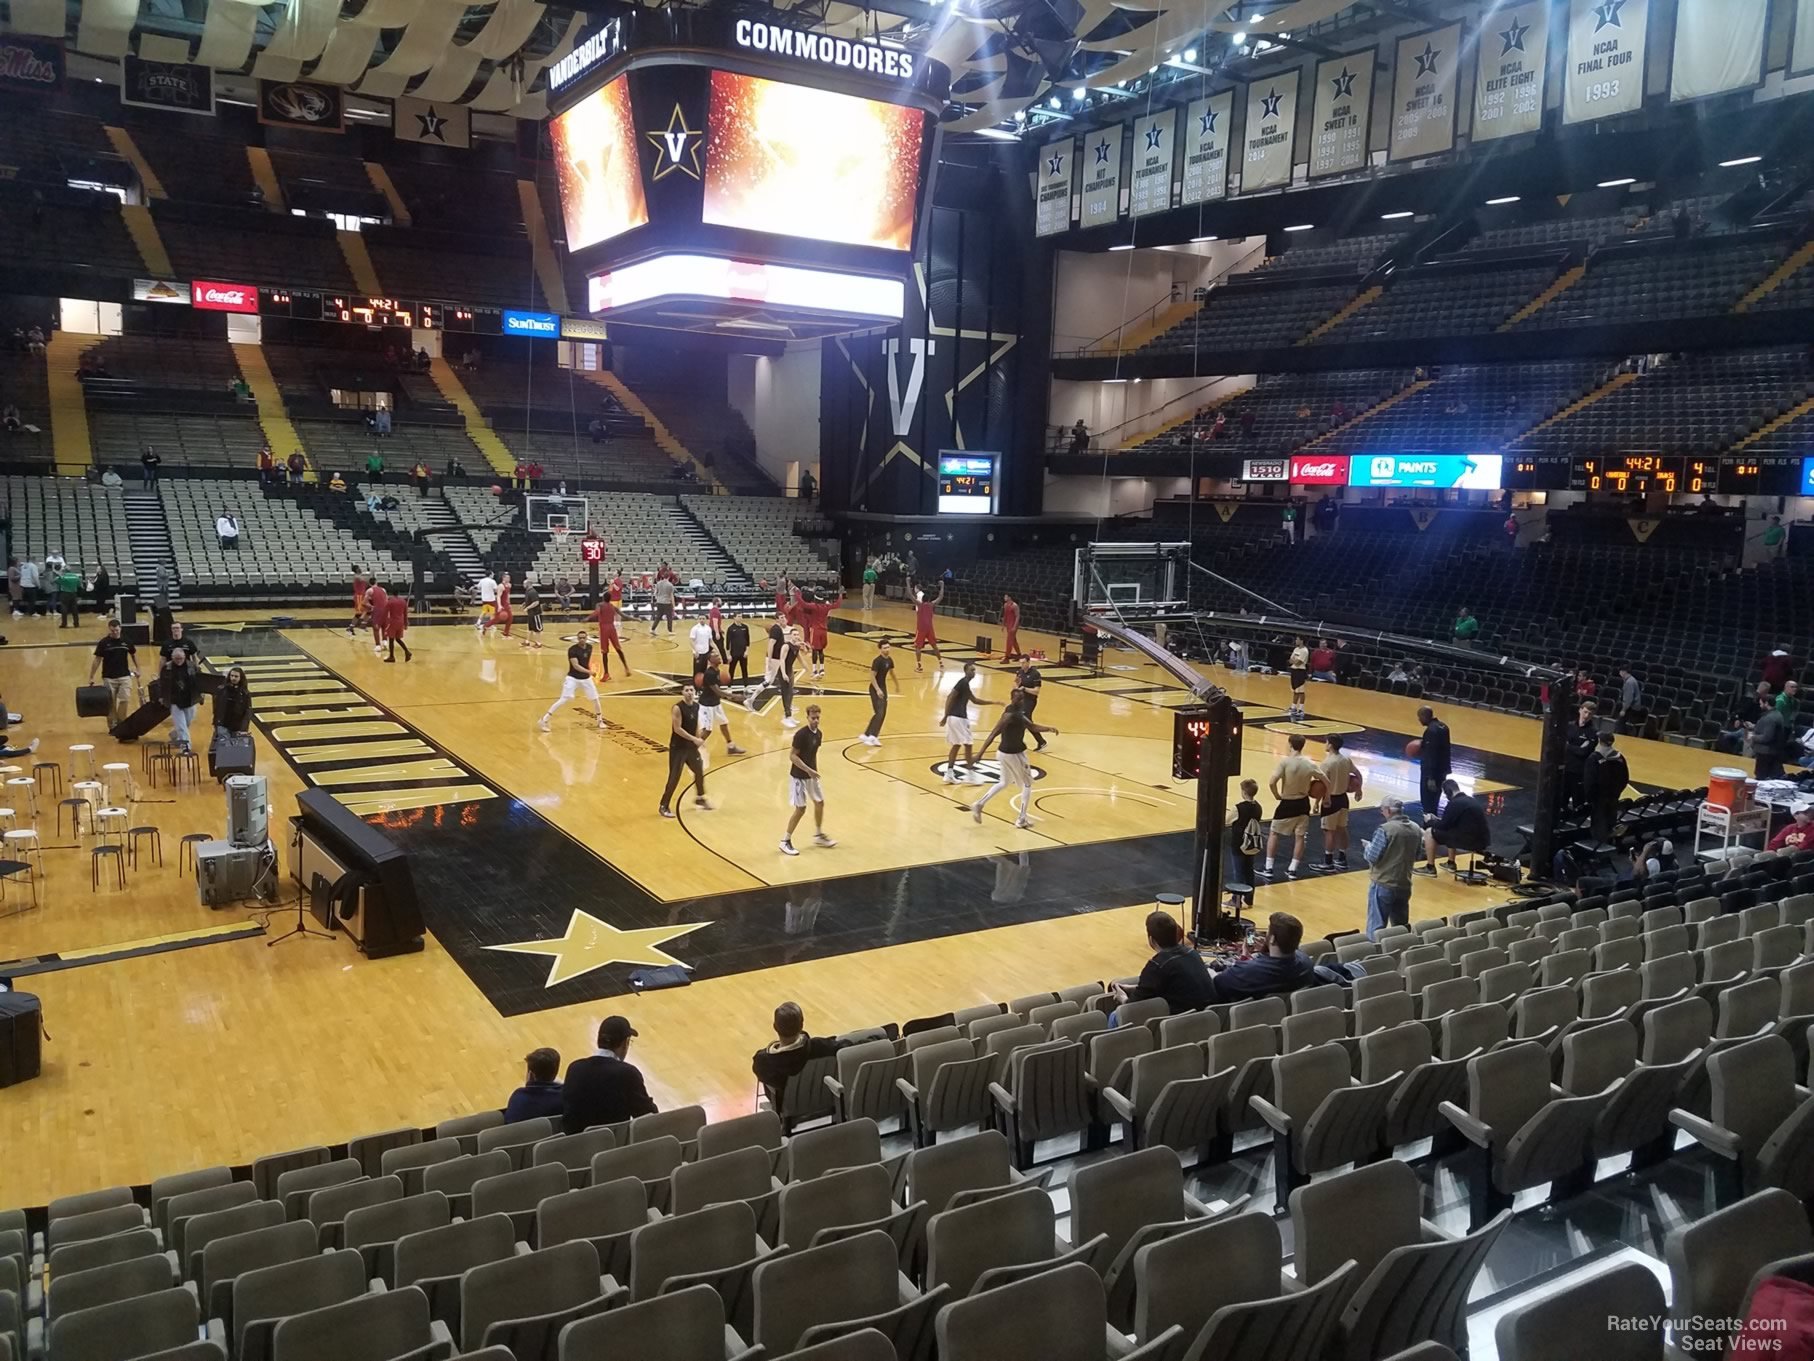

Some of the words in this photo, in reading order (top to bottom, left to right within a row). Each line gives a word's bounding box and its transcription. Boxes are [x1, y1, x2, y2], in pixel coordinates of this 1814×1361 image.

[736, 19, 913, 78] COMMODORES
[1593, 39, 1618, 56] NCAA
[549, 28, 607, 90] VANDERBILT
[1578, 58, 1604, 75] FINAL
[1607, 51, 1632, 68] FOUR
[1500, 61, 1522, 76] NCAA
[149, 75, 187, 91] STATE
[1486, 78, 1508, 92] ELITE
[1510, 70, 1535, 87] EIGHT
[1415, 84, 1435, 98] NCAA
[1585, 80, 1620, 103] 1993
[1406, 97, 1429, 111] SWEET
[1433, 94, 1442, 105] 16
[1483, 91, 1505, 106] 1992
[1333, 105, 1351, 119] NCAA
[1481, 107, 1504, 121] 2001
[1513, 100, 1536, 114] 2002
[1324, 117, 1345, 131] SWEET
[1349, 115, 1357, 127] 16
[1261, 125, 1277, 137] NCAA
[1200, 141, 1214, 153] NCAA
[1249, 131, 1288, 150] TOURNAMENT
[664, 133, 686, 162] V
[1146, 156, 1159, 167] NCAA
[1190, 148, 1224, 166] TOURNAMENT
[1248, 150, 1265, 162] 2014
[1136, 162, 1168, 179] TOURNAMENT
[1085, 176, 1115, 193] CHAMPIONS
[1040, 187, 1068, 203] CHAMPIONS
[205, 288, 245, 304] Coca-Cola
[335, 298, 343, 308] 4
[369, 298, 398, 310] 44:21
[342, 310, 349, 321] 0
[423, 306, 431, 316] 4
[364, 312, 372, 324] 0
[404, 316, 411, 327] 0
[424, 317, 432, 328] 0
[882, 338, 935, 435] V
[1251, 465, 1281, 473] 1510
[1300, 463, 1336, 477] Coca-Cola
[1398, 462, 1439, 474] PAINTS
[1585, 461, 1594, 473] 4
[1626, 457, 1660, 470] 44:21
[1693, 462, 1702, 474] 4
[945, 484, 951, 493] 0
[1591, 476, 1600, 489] 0
[1617, 478, 1626, 490] 0
[1666, 478, 1675, 491] 0
[1692, 478, 1701, 491] 0
[984, 485, 990, 494] 0
[1222, 505, 1231, 516] A
[1637, 520, 1649, 533] C
[587, 548, 600, 559] 30
